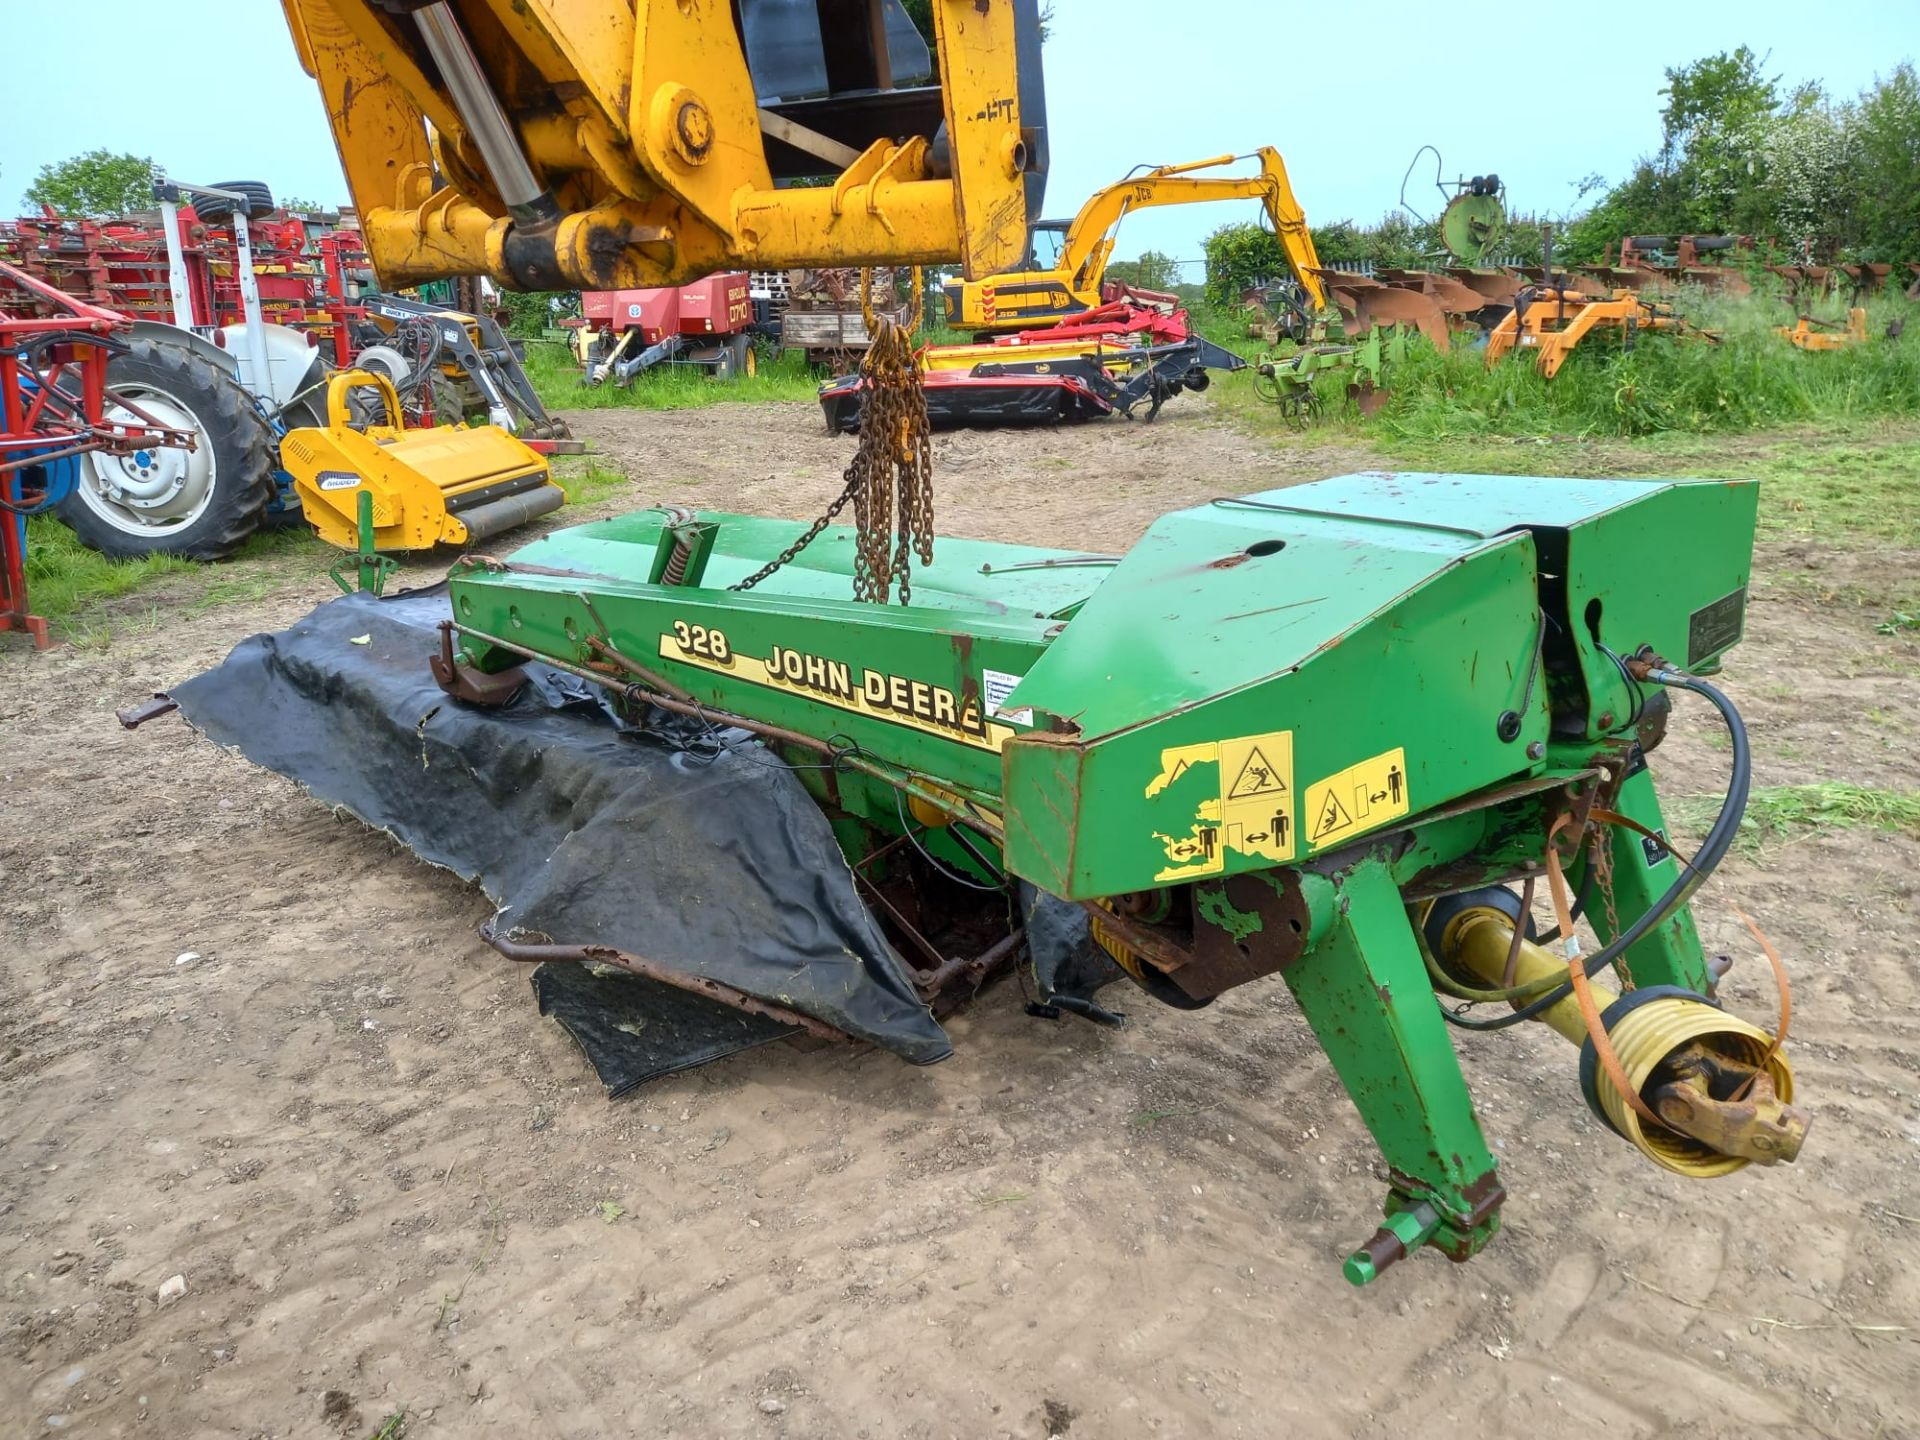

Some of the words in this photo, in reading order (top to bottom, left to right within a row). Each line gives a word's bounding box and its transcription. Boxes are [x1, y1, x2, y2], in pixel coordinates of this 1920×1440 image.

[1135, 186, 1152, 202] JCB
[673, 619, 732, 665] 328
[764, 645, 854, 702] JOHN
[863, 668, 986, 740] DEERE
